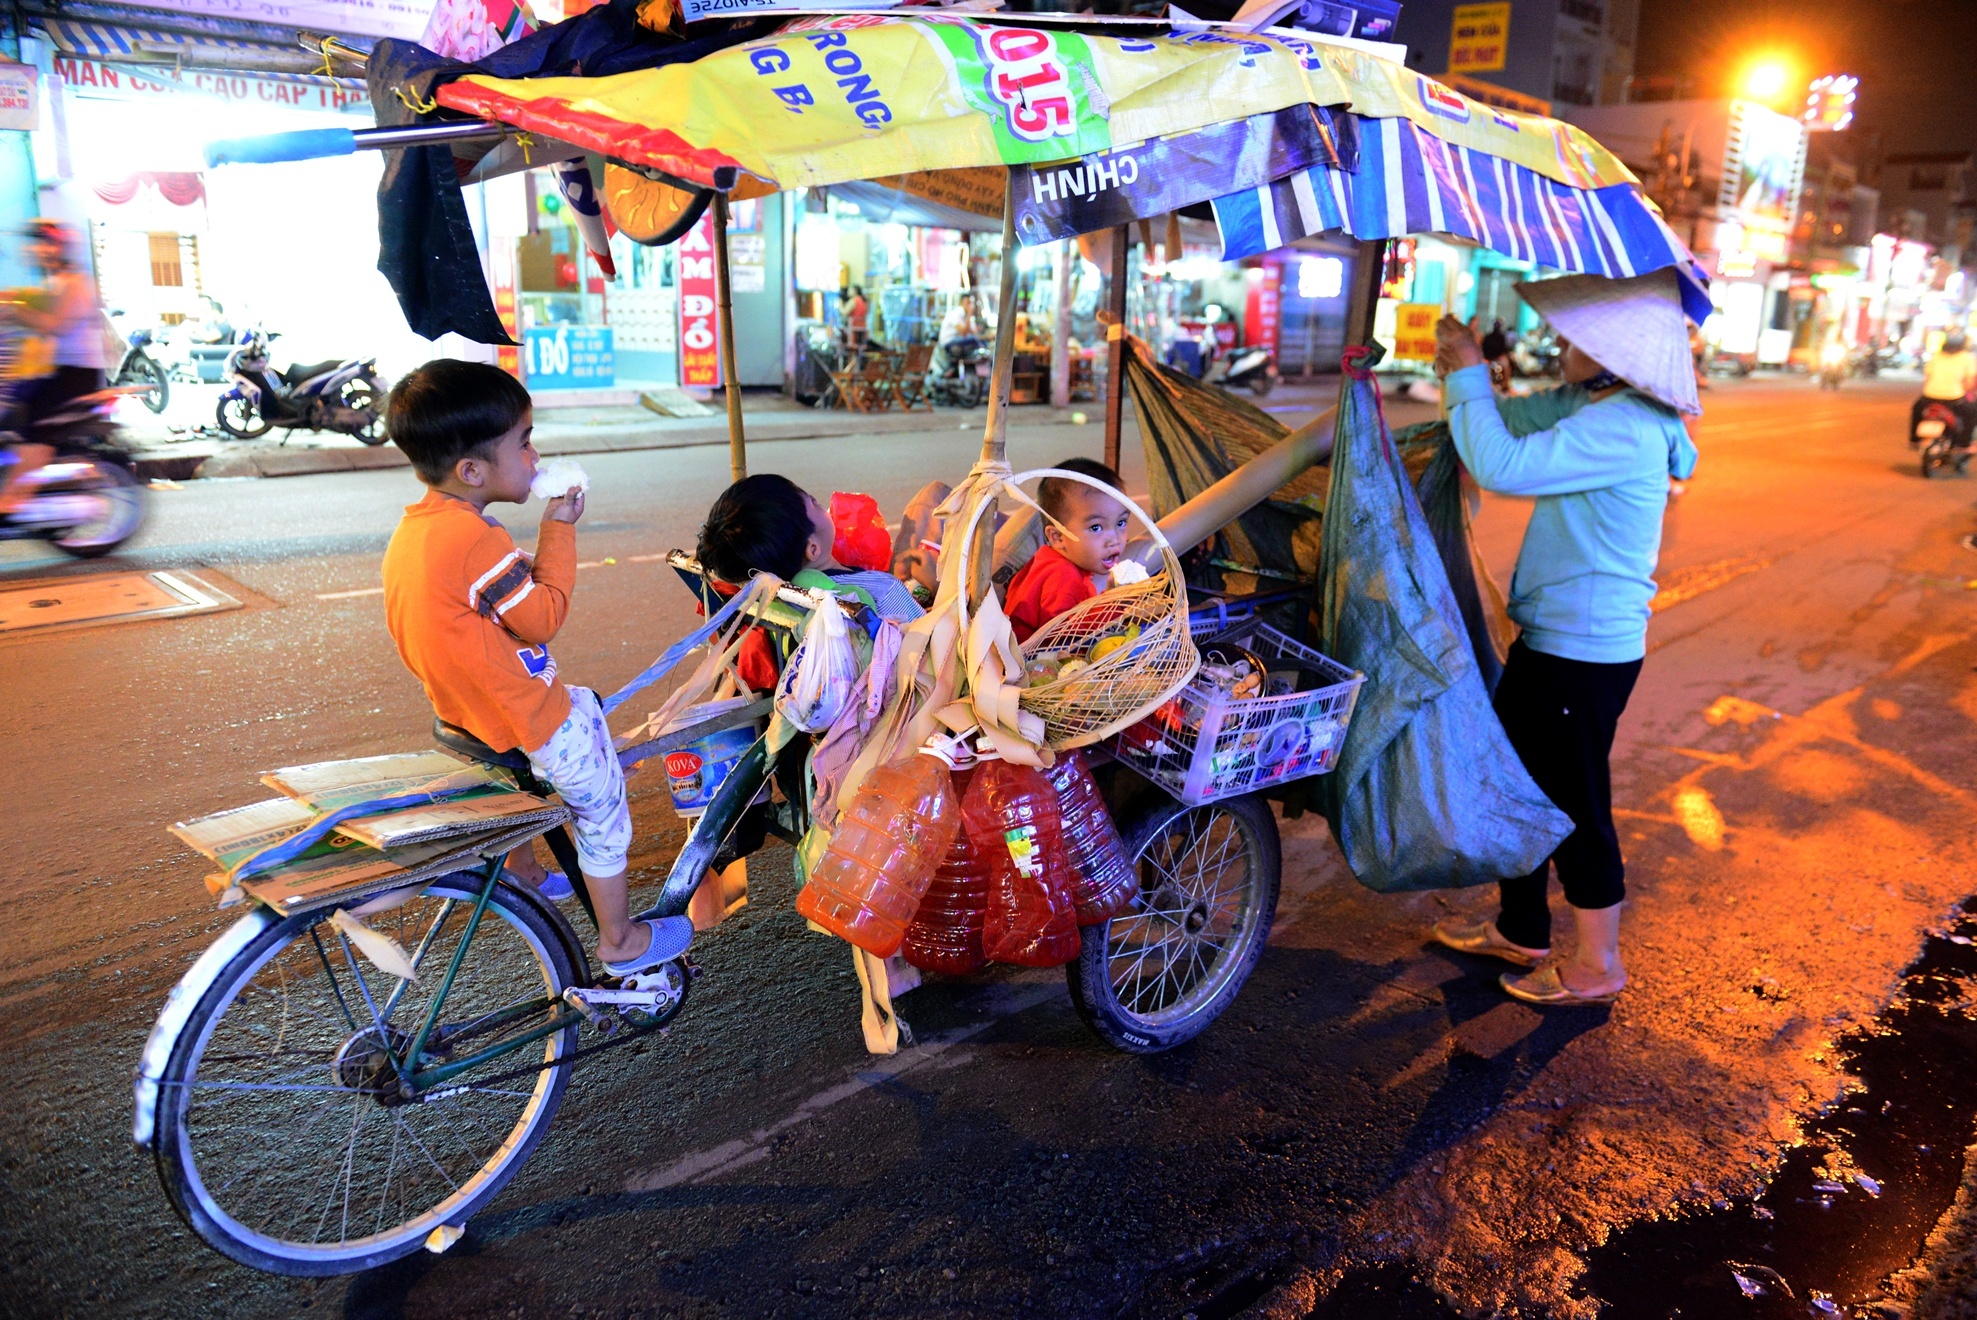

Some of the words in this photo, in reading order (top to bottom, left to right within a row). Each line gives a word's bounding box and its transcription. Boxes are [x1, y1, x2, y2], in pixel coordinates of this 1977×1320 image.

[979, 24, 1071, 132] 015
[1032, 155, 1139, 204] CHÍNH
[667, 758, 697, 773] KOVA
[1122, 1031, 1150, 1046] MAXXIS
